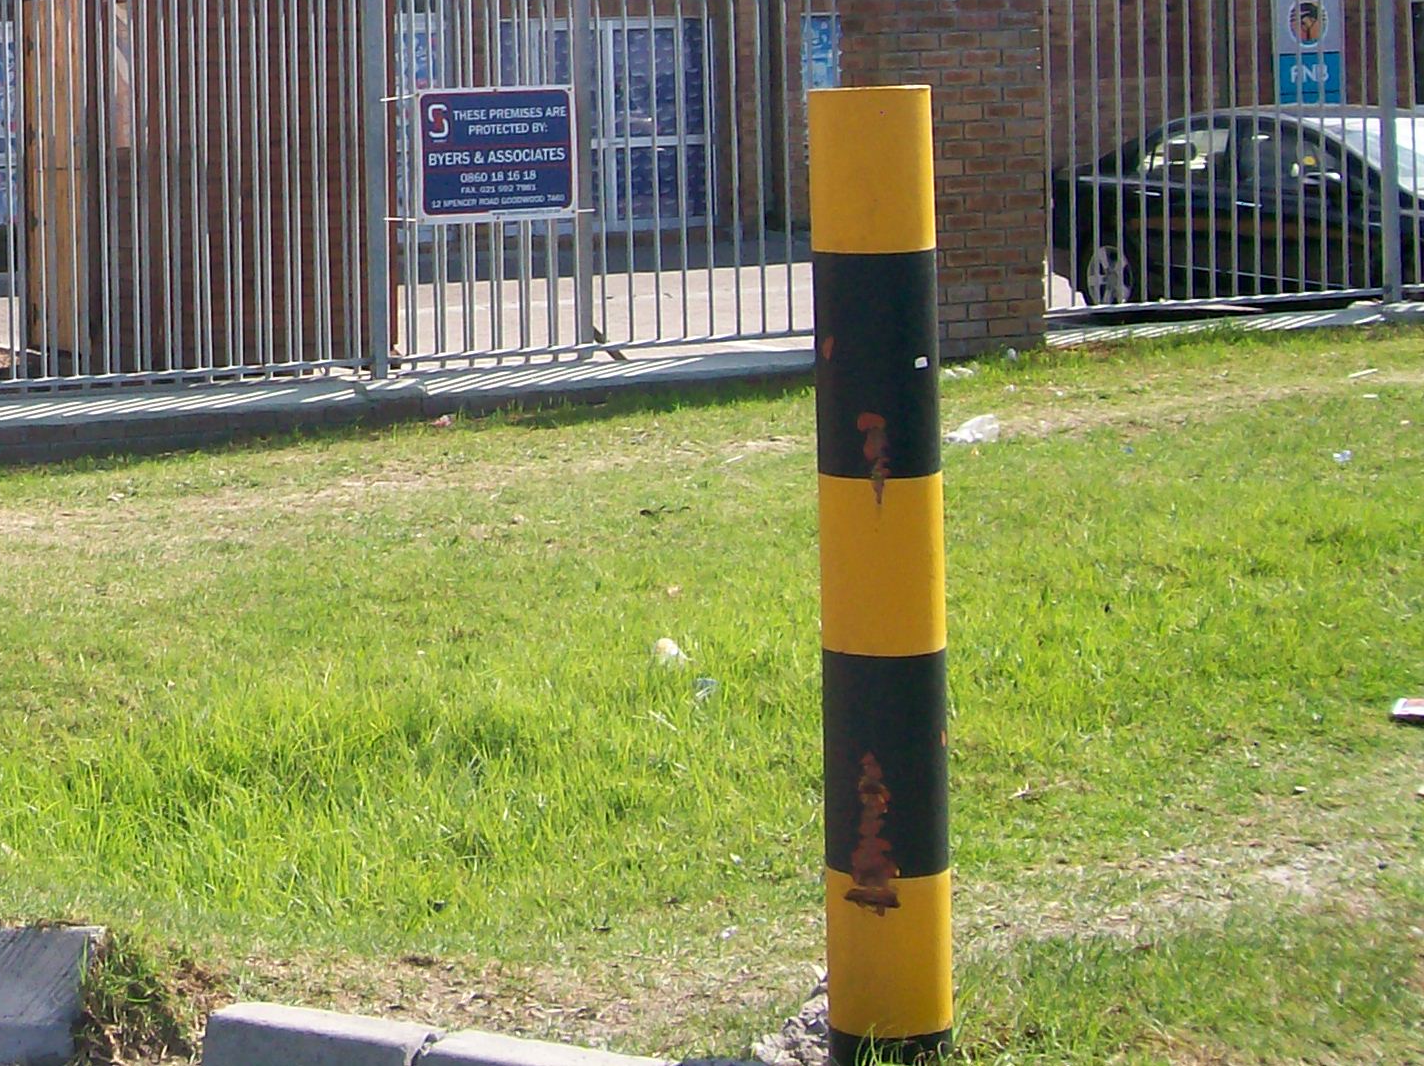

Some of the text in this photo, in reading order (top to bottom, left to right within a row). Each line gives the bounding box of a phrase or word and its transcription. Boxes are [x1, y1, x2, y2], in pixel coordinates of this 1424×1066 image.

[453, 110, 487, 121] THESE
[489, 107, 543, 120] PREMISES
[545, 106, 567, 118] ARE
[468, 123, 530, 136] PROTECTED
[428, 147, 566, 166] BYERS & ASSOCIATES
[460, 172, 488, 183] 0860
[491, 171, 505, 182] 18
